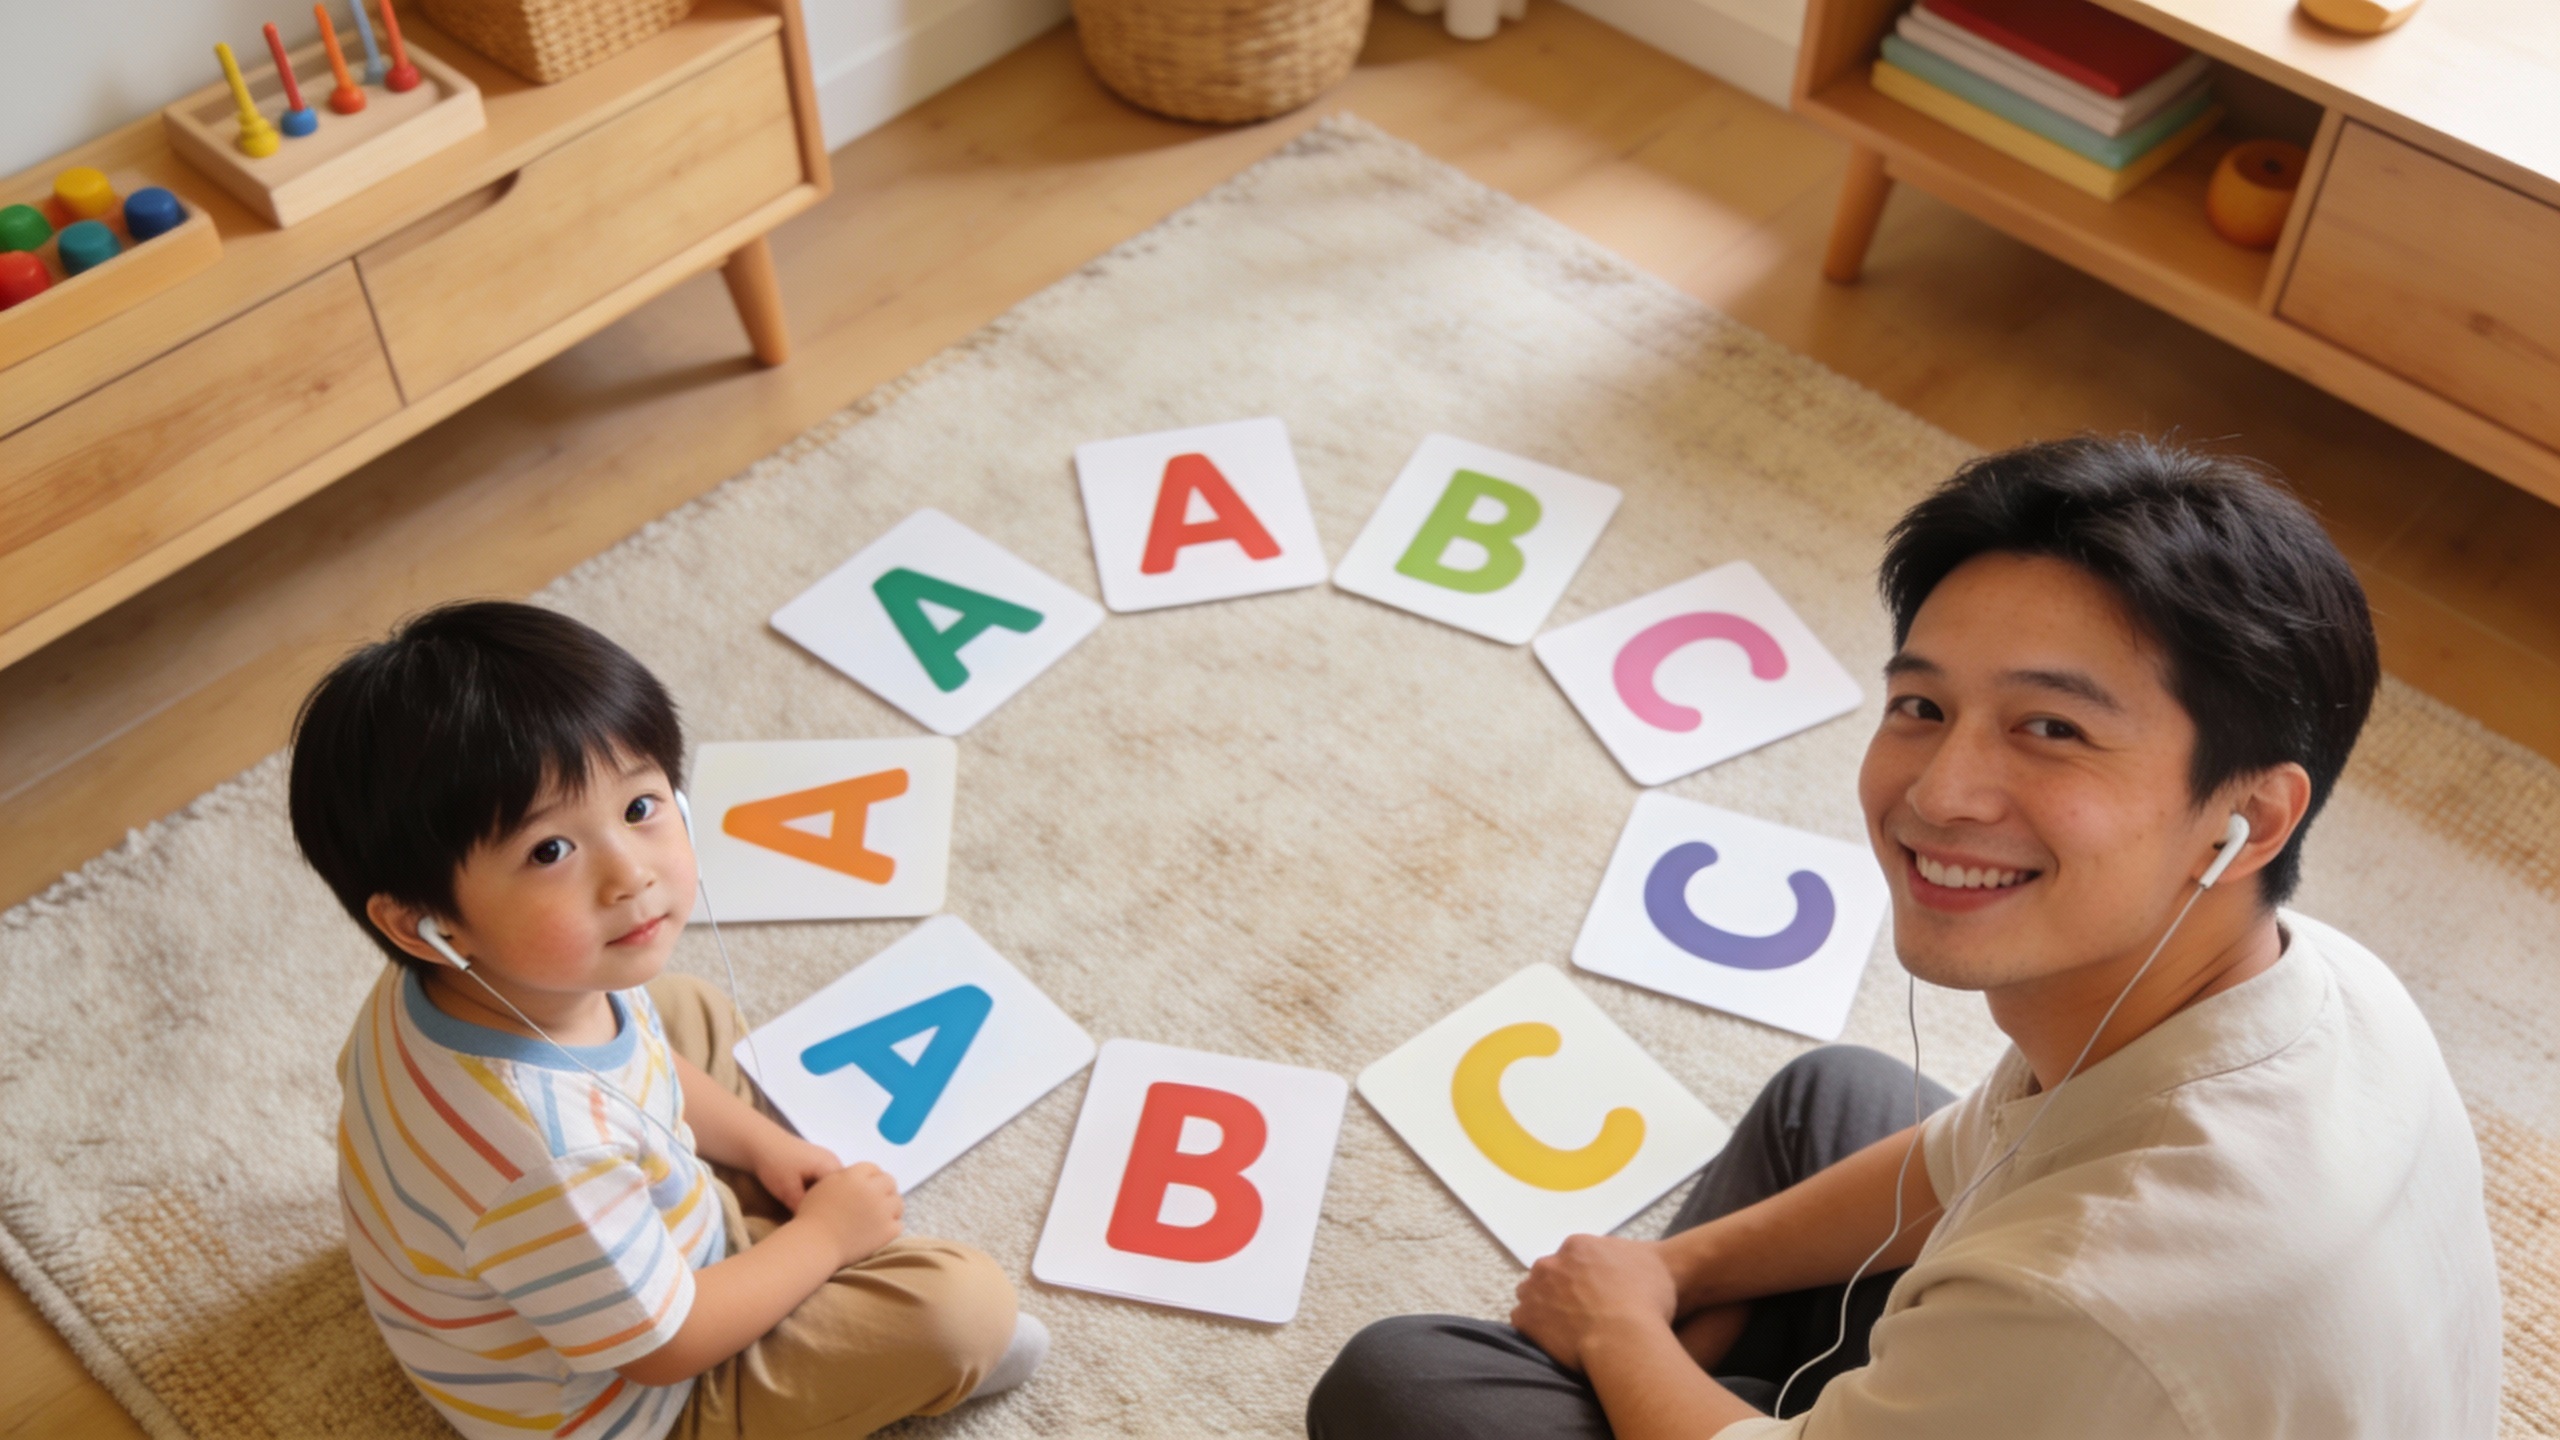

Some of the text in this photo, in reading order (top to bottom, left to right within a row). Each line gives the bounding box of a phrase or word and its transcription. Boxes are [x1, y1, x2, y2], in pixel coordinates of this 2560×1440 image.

[1140, 453, 1282, 575] A
[1396, 470, 1541, 593] B
[873, 568, 1043, 692] A
[1614, 613, 1787, 731] C
[721, 768, 909, 885] A
[1645, 842, 1835, 970] C
[800, 984, 993, 1146] A
[1451, 1022, 1646, 1192] C
[1106, 1082, 1267, 1263] B
